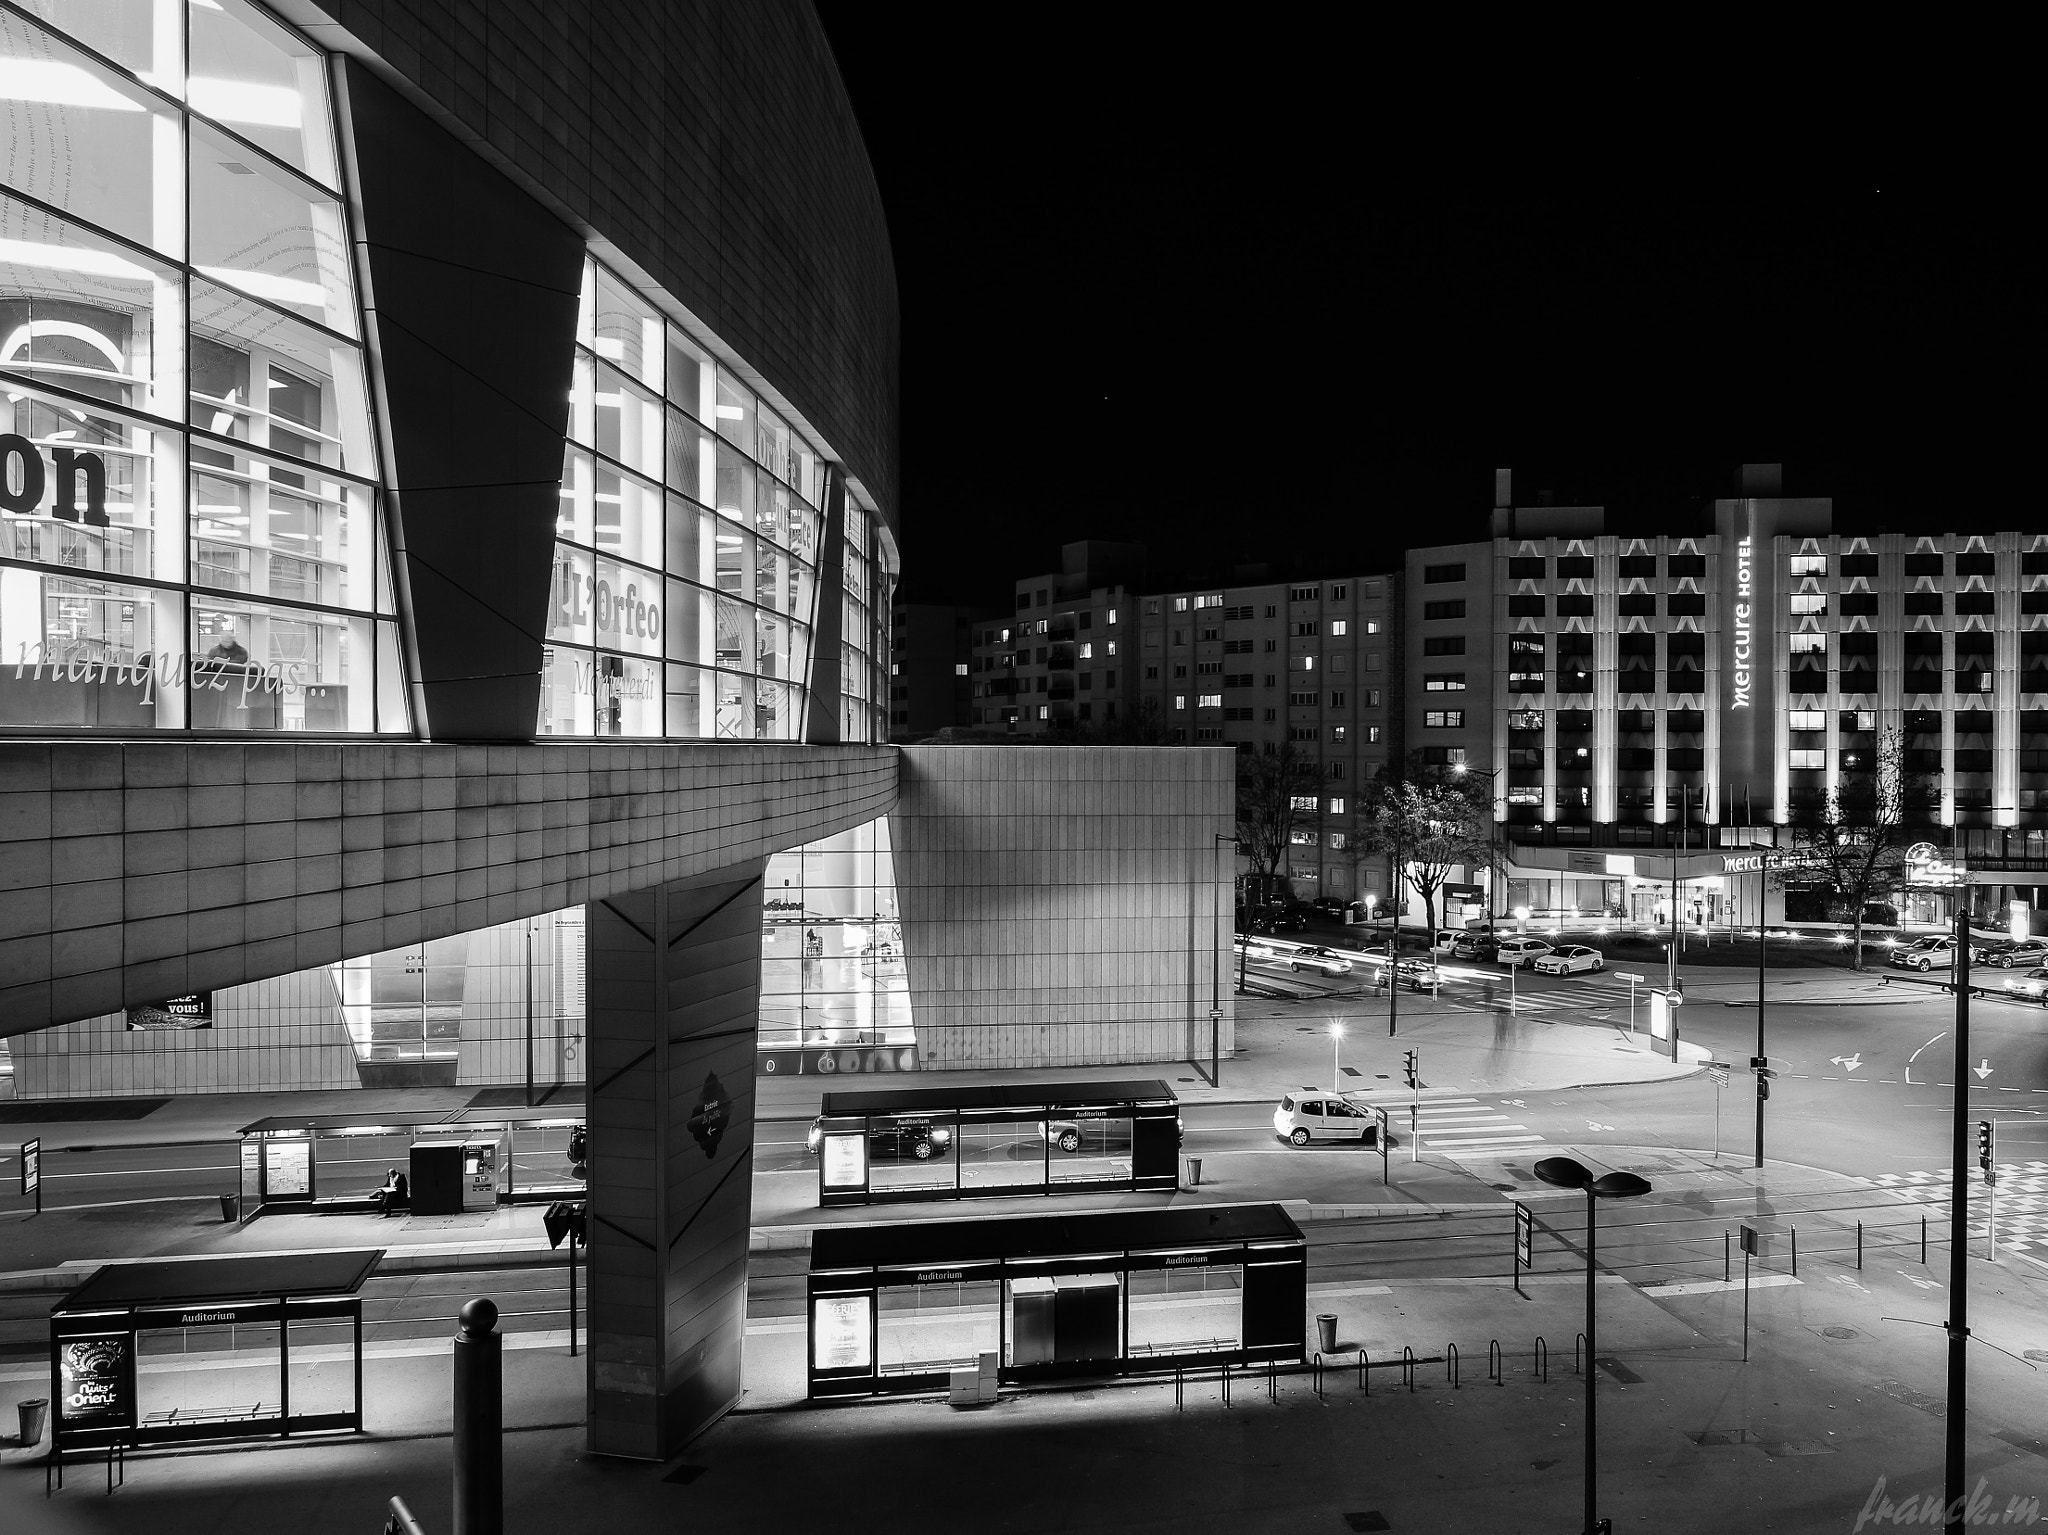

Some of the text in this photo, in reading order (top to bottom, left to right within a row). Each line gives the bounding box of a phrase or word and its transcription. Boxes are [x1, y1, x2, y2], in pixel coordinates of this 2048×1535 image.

[1738, 535, 1751, 597] HOTEL
[16, 640, 230, 706] manquez
[571, 660, 655, 701] Monteverdi
[168, 1004, 199, 1014] vous
[1165, 1255, 1208, 1265] Auditorium
[917, 1270, 963, 1281] Auditorium
[181, 1311, 236, 1323] Auditorium
